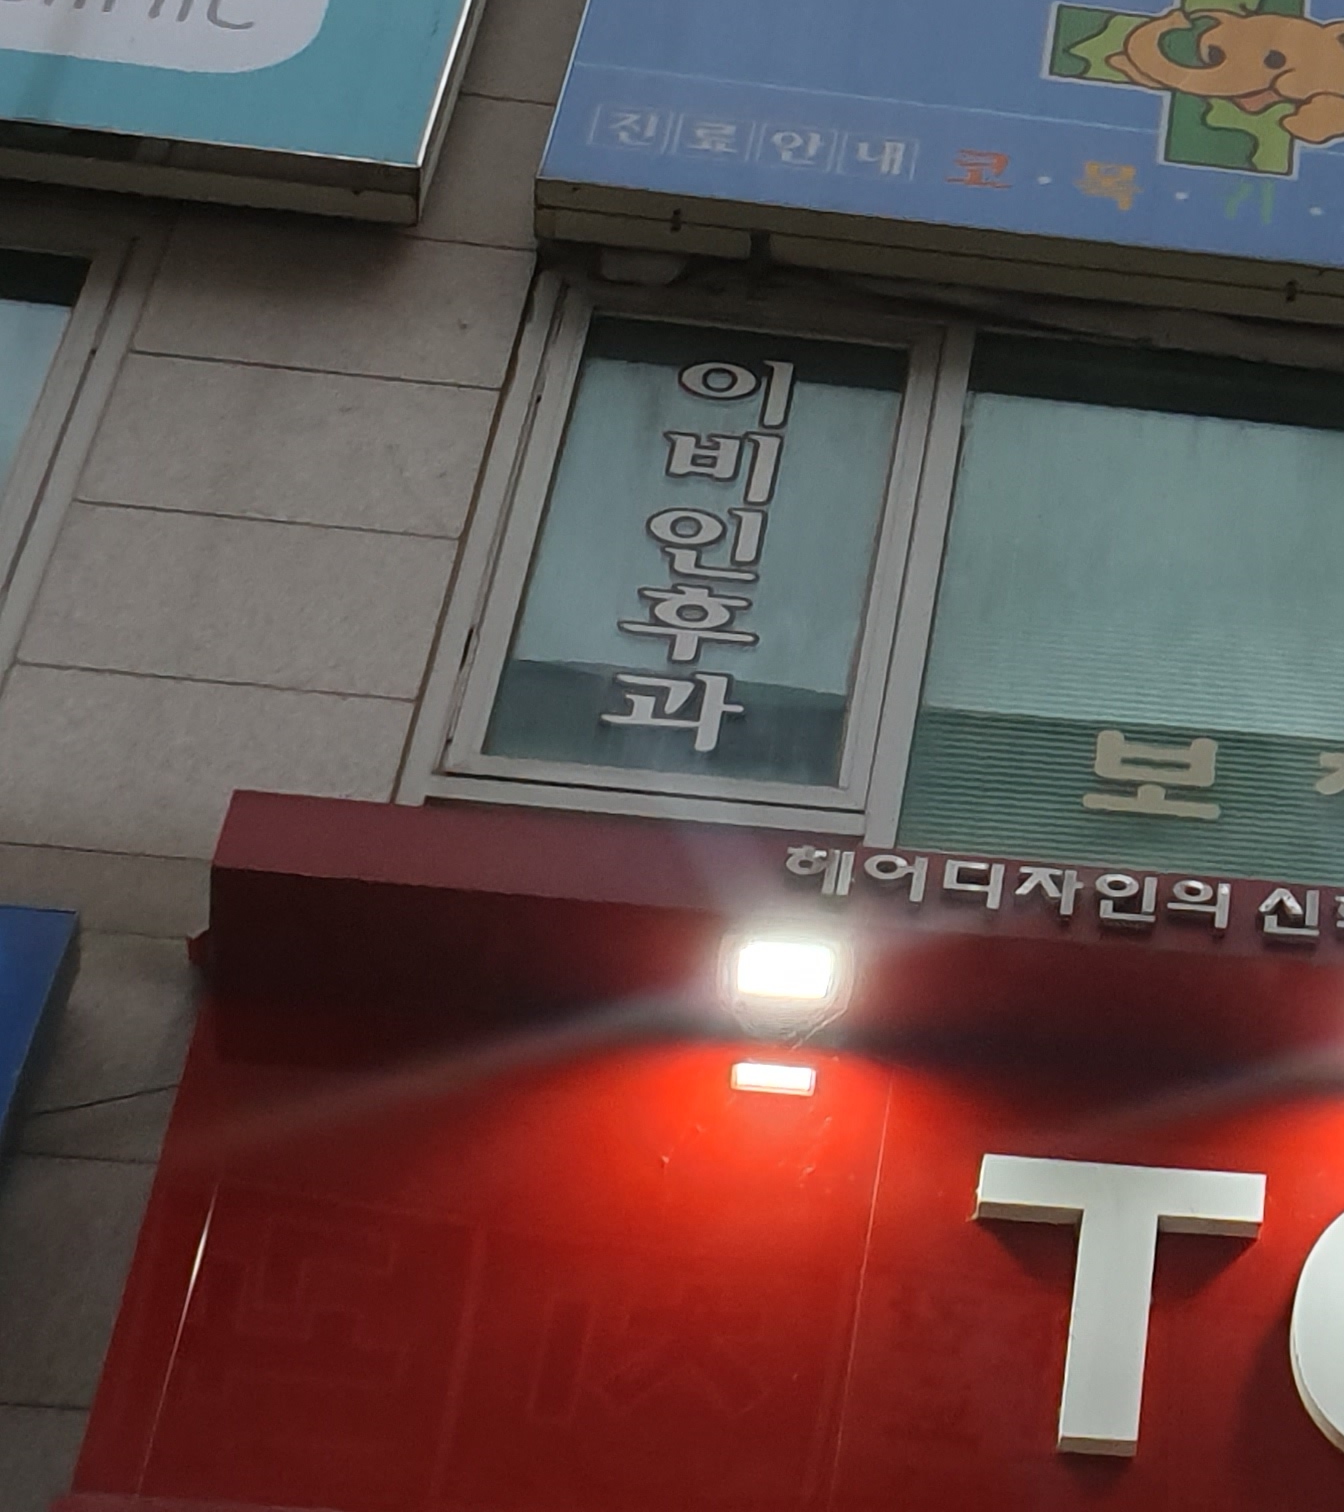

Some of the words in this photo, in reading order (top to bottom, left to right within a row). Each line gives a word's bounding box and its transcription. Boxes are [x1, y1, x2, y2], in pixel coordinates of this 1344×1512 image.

[607, 110, 910, 178] 진료안내
[600, 358, 796, 753] 이비인후과
[785, 843, 1232, 930] 헤어디자인의
